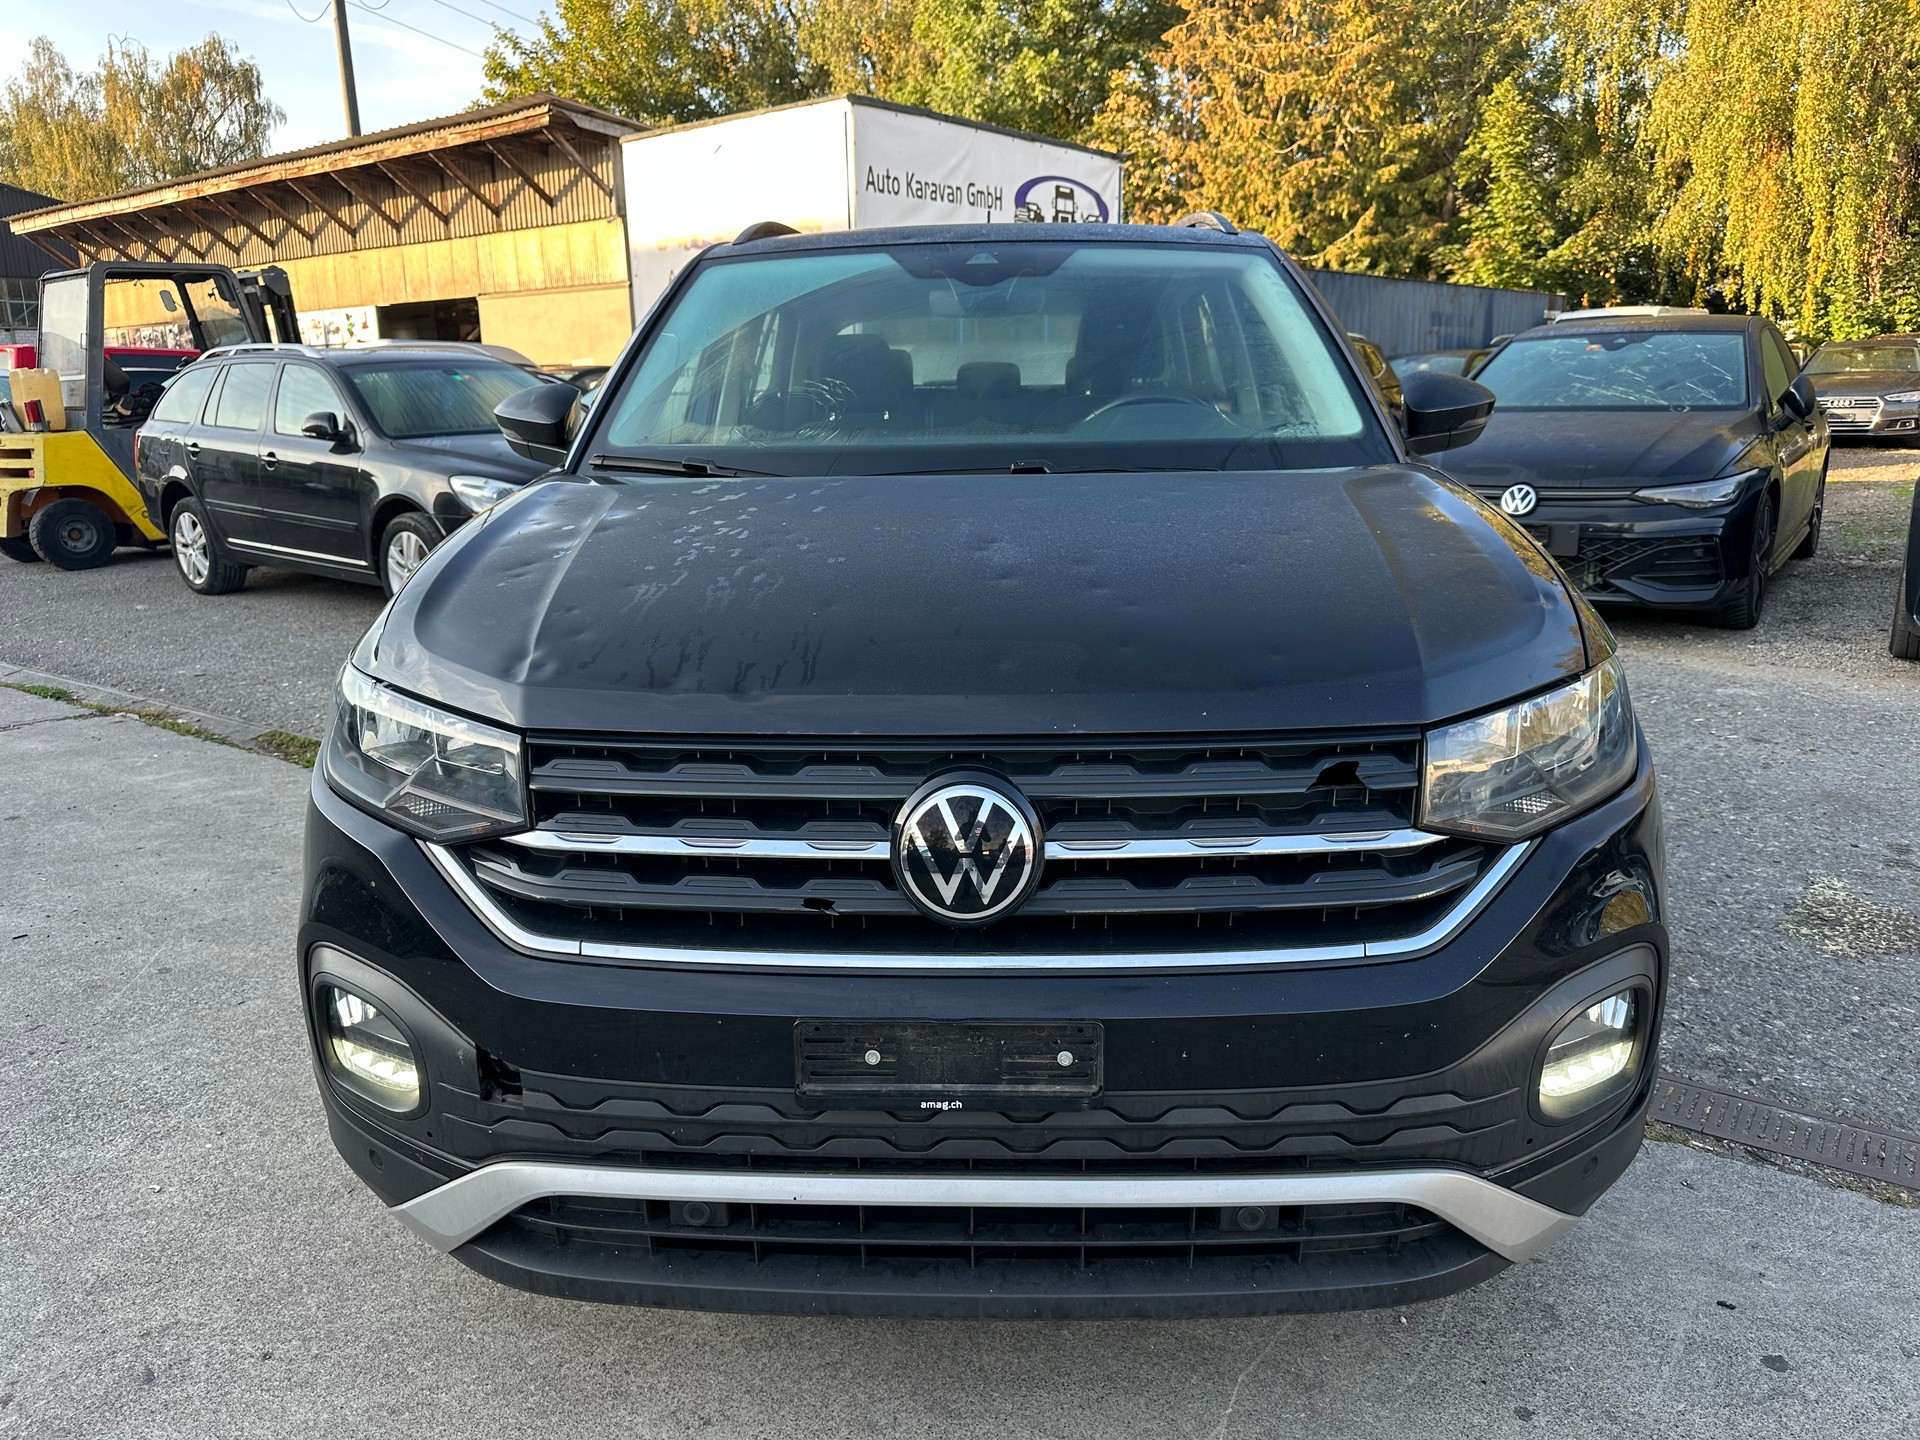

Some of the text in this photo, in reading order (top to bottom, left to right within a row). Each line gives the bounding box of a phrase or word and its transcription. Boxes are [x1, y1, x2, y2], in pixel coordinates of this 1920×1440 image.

[865, 165, 1003, 211] Auto Karavan GmbH
[1502, 485, 1536, 514] VW
[901, 786, 1033, 917] VW
[920, 1100, 963, 1111] amag.ch
